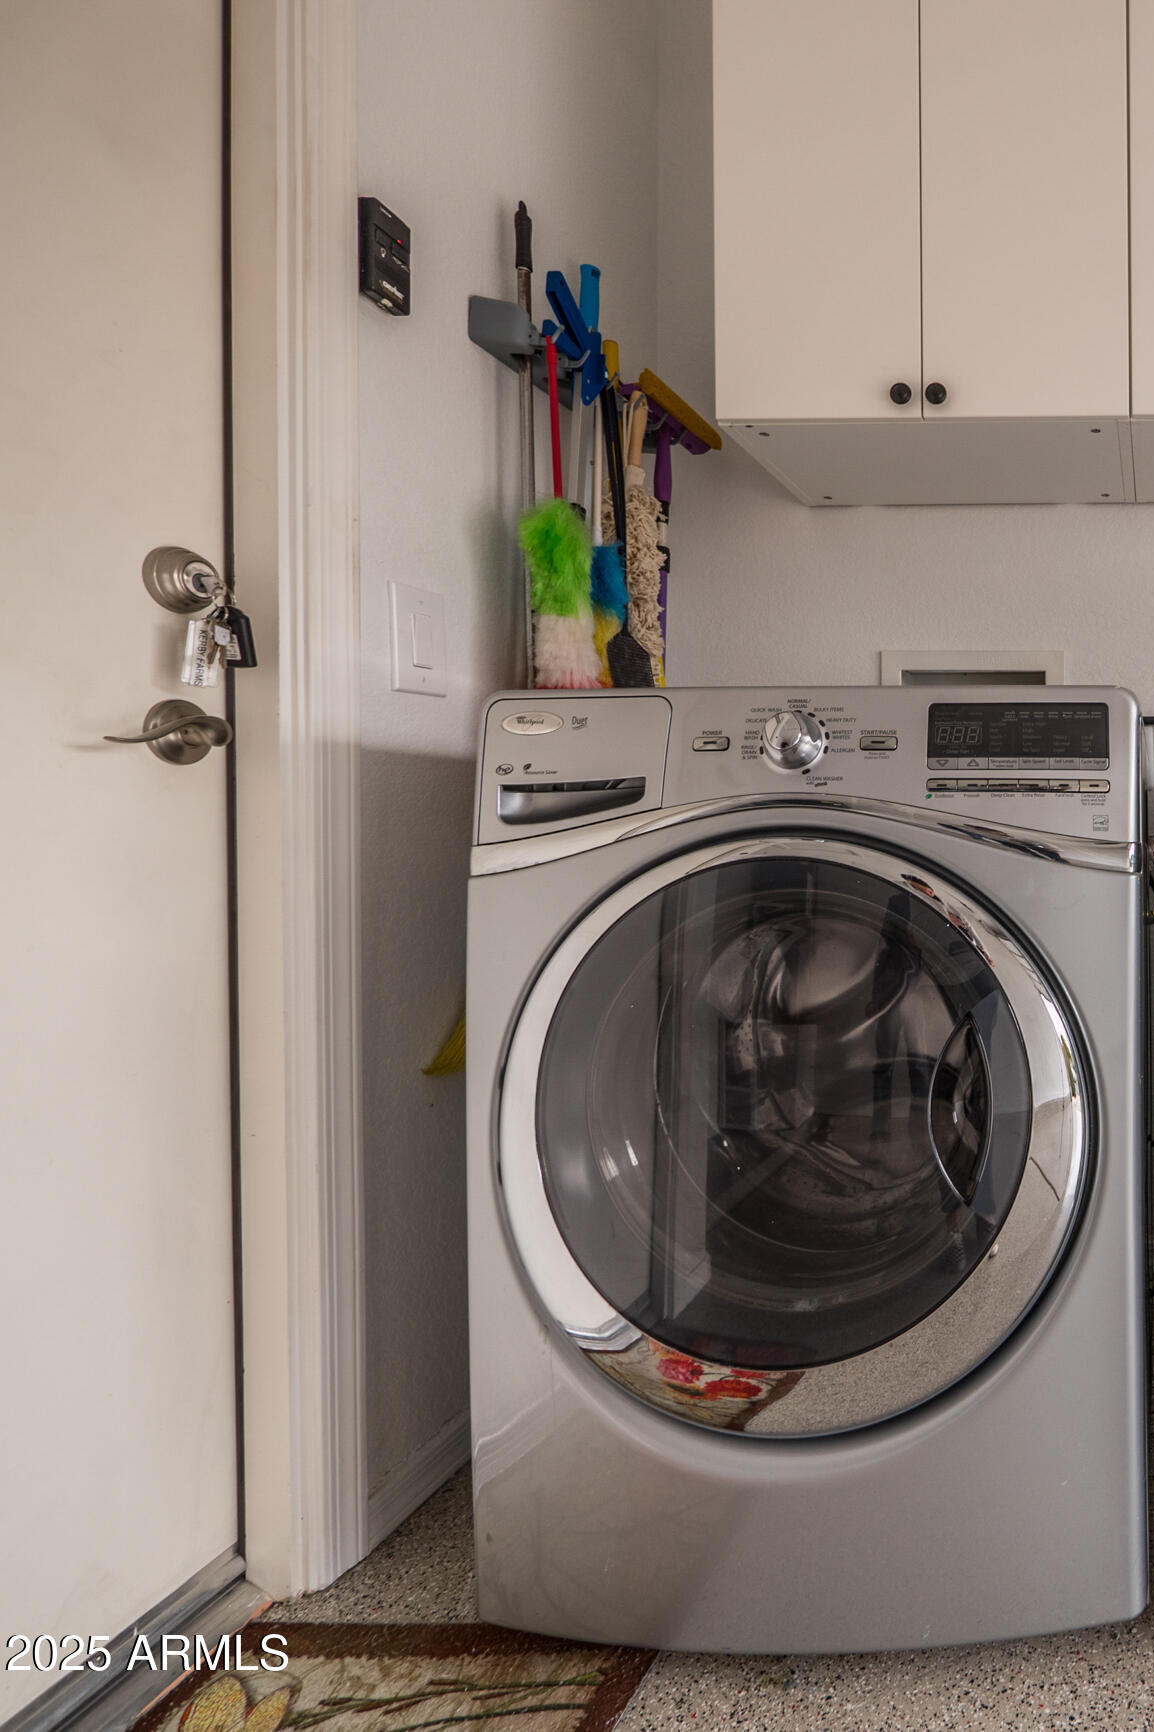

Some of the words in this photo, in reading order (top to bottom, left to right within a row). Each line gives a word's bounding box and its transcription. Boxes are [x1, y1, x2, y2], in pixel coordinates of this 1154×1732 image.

[197, 629, 209, 657] KERBY
[193, 657, 206, 688] FARMS
[516, 717, 544, 726] Whirlpool
[572, 716, 588, 725] Duet
